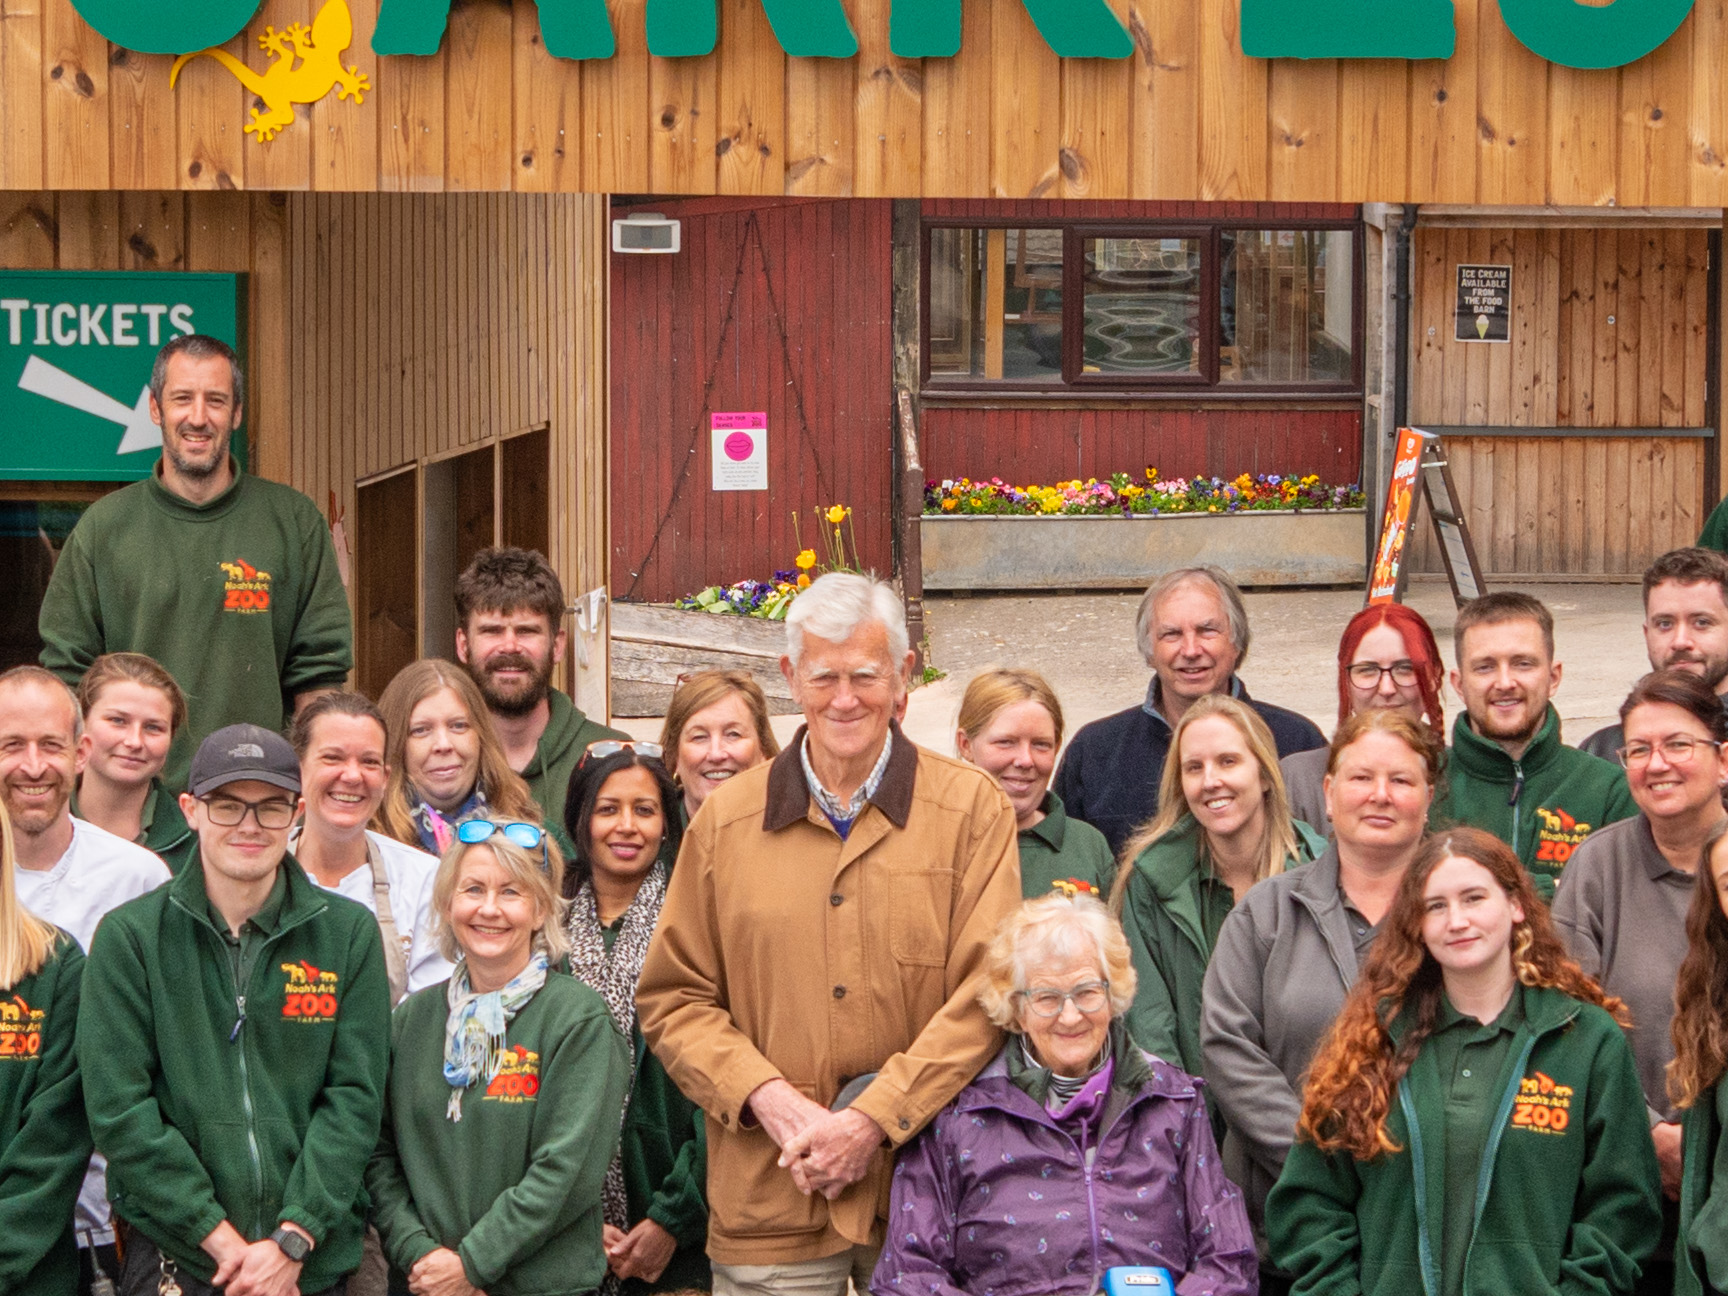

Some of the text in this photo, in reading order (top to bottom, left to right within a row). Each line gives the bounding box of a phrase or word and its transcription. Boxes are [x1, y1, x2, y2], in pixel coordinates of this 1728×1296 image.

[1462, 269, 1507, 279] ICE CREAM
[1461, 278, 1507, 288] AVAILABLE
[1472, 288, 1495, 296] FROM
[1464, 296, 1503, 305] THE FOOD
[1474, 305, 1495, 314] BARN
[0, 299, 195, 347] TICKETS
[224, 589, 270, 609] ZOO
[1570, 833, 1588, 844] Ar
[285, 983, 336, 994] Noah's Ark
[282, 993, 338, 1017] ZOO
[500, 1064, 522, 1075] oah's
[486, 1074, 539, 1096] ZOO
[1513, 1103, 1569, 1130] ZOO
